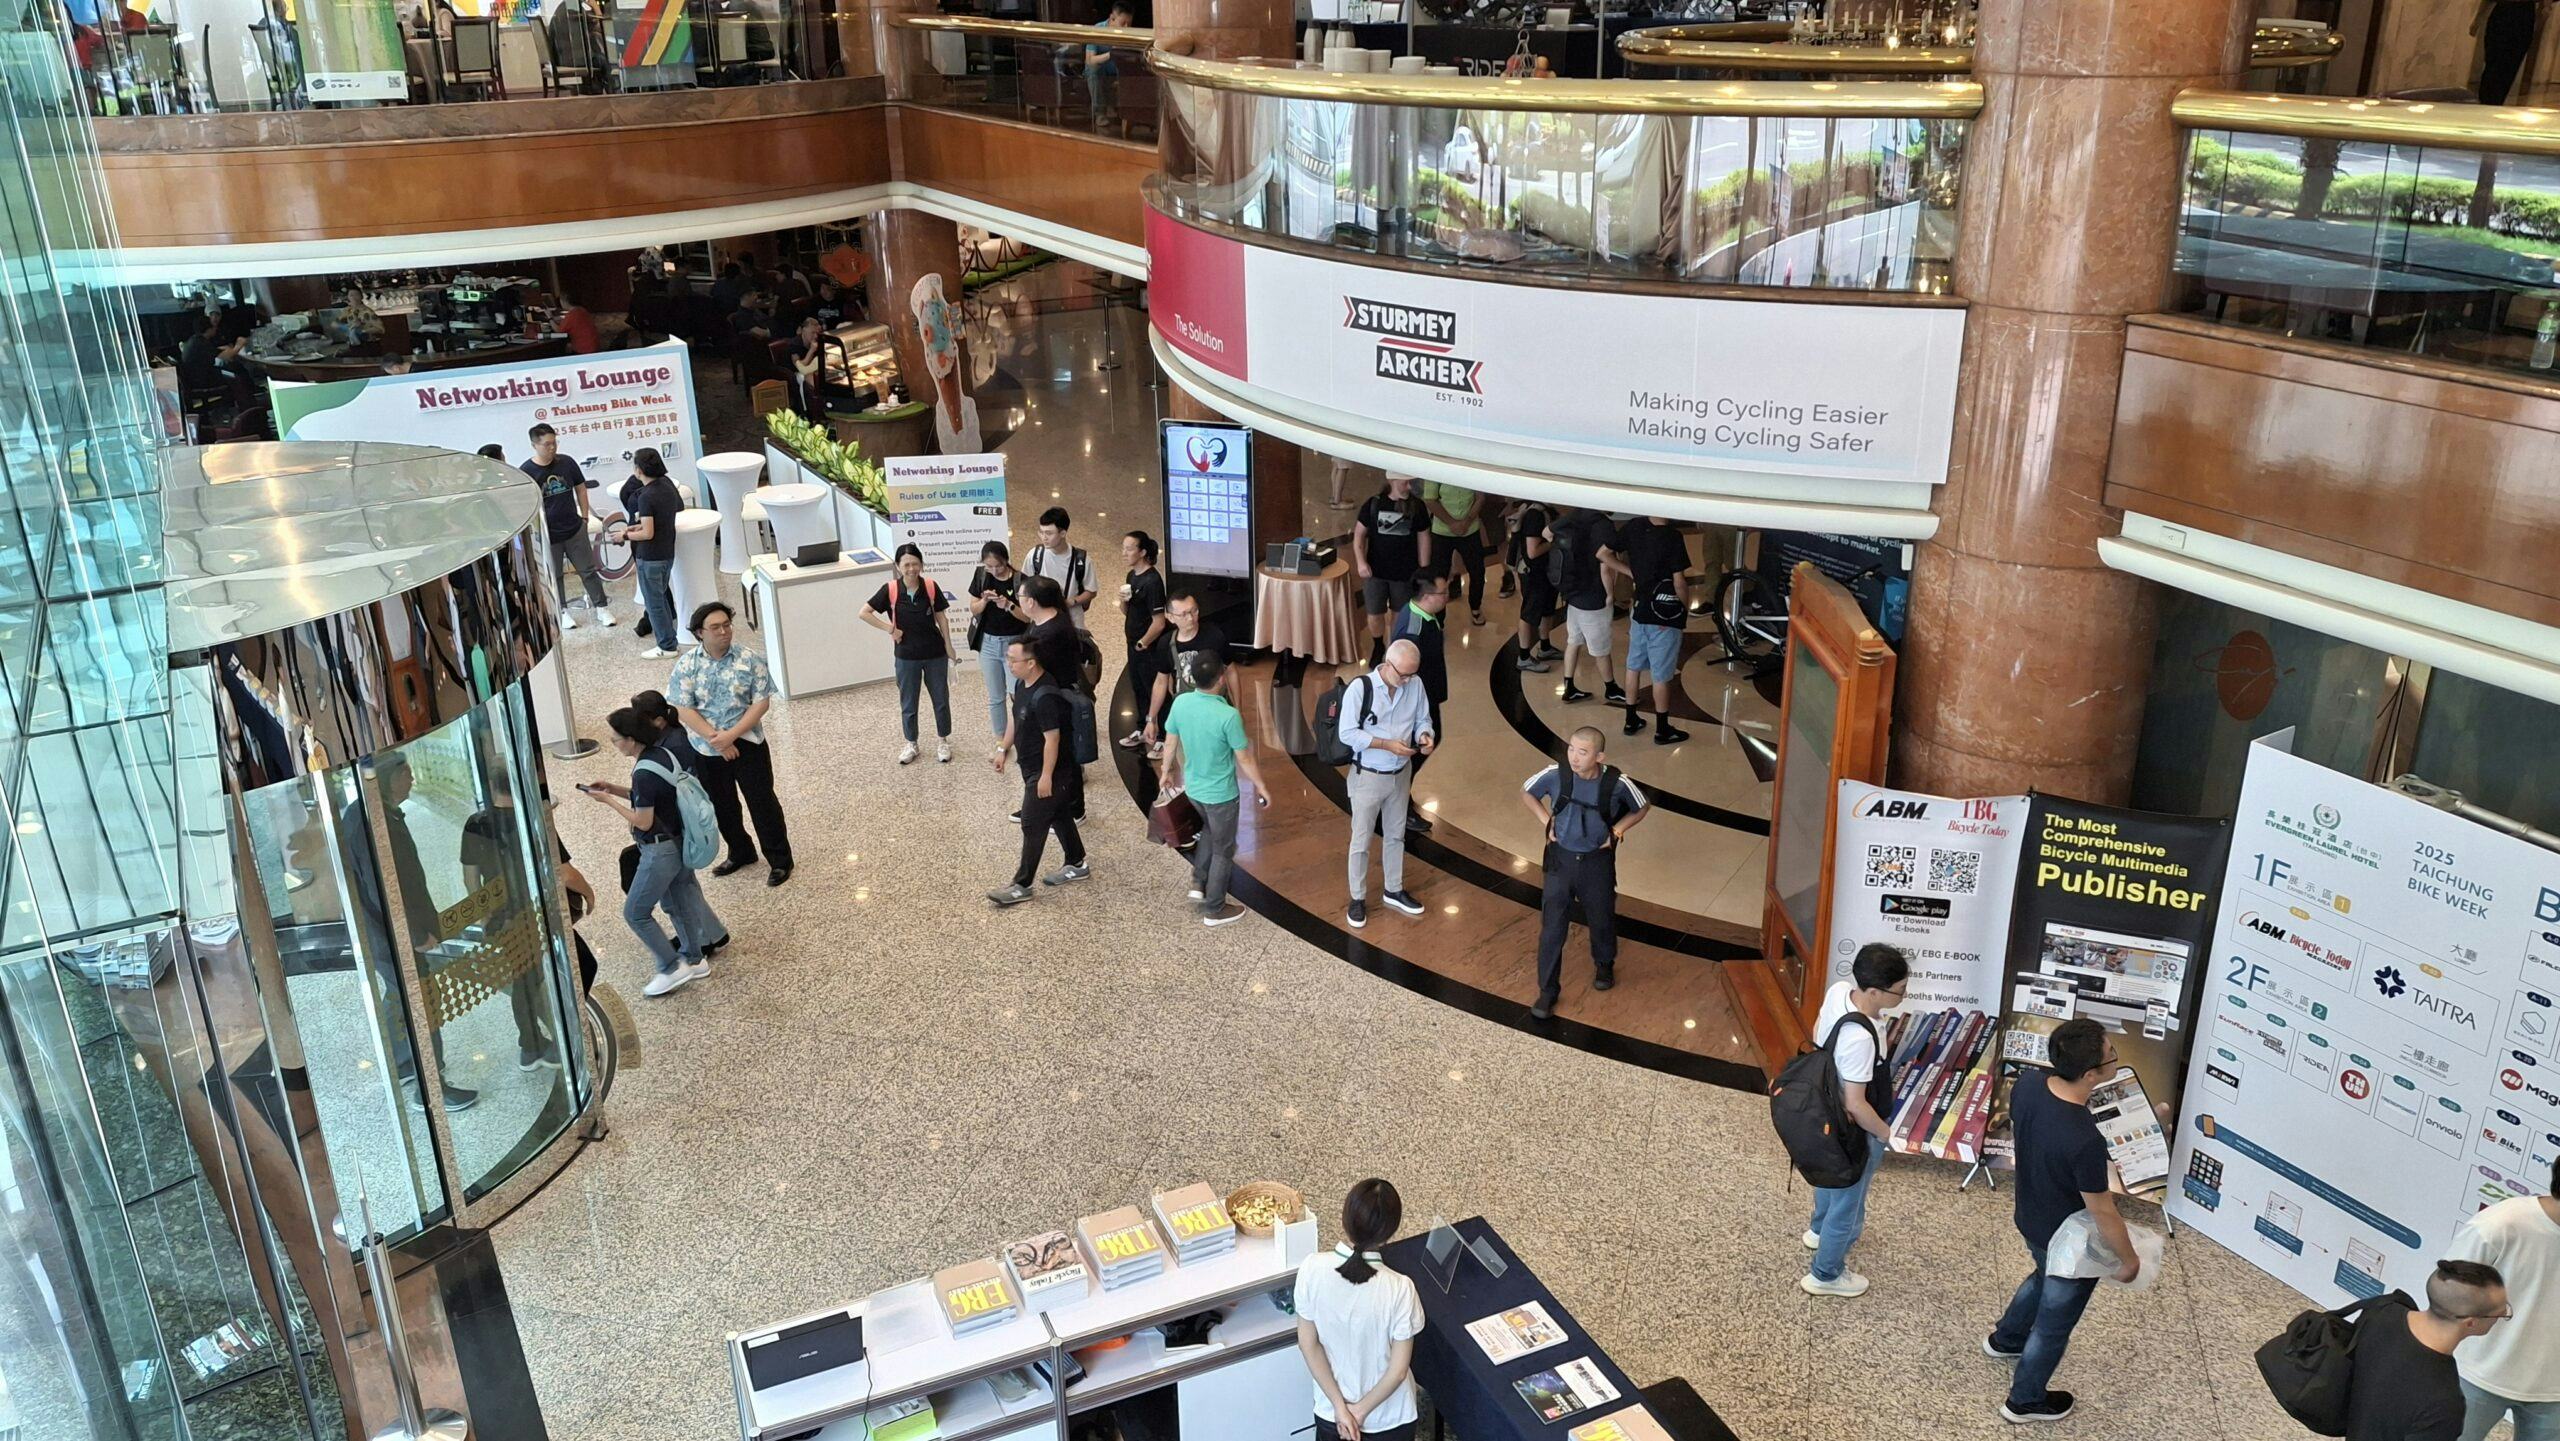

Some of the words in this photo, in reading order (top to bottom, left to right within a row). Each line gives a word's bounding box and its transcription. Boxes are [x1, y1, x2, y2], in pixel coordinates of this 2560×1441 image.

[1358, 302, 1452, 339] STURMEY
[1174, 313, 1188, 336] The
[1188, 323, 1224, 353] Solution
[1379, 350, 1466, 386] ARCHER
[416, 376, 568, 409] Networking
[577, 366, 671, 390] Lounge
[551, 402, 608, 416] Taichung
[612, 398, 638, 410] Bike
[641, 394, 672, 406] Week
[1436, 392, 1455, 402] EST.
[1461, 396, 1484, 408] 1902
[1630, 390, 1708, 418] Making
[1716, 398, 1803, 426] Cycling
[1812, 404, 1889, 426] Easier
[628, 426, 679, 440] 9.16-9.18
[1628, 416, 1707, 444] Making
[1714, 424, 1801, 452] Cycling
[1810, 431, 1874, 452] Safer
[892, 466, 954, 476] Networking
[958, 464, 999, 474] Lounge
[900, 492, 924, 500] Rules
[914, 512, 939, 520] Buyers
[978, 507, 998, 515] FREE
[1840, 536, 1850, 545] to
[1850, 540, 1882, 555] market.
[1866, 800, 1929, 820] ABM
[1960, 800, 2000, 822] TBG
[1947, 820, 1979, 834] Bicycle
[1982, 824, 2010, 838] Today
[2045, 813, 2074, 828] The
[2078, 818, 2118, 835] Most
[2042, 828, 2166, 858] Comprehensive
[2265, 819, 2314, 843] EVERGREEN
[2316, 840, 2348, 857] LAUREL
[2350, 853, 2380, 870] HOTEL
[2414, 842, 2455, 866] 2025
[2040, 844, 2098, 863] Bicycle
[2101, 852, 2188, 878] Multimedia
[2254, 853, 2292, 887] 1F
[2036, 862, 2206, 912] Publisher
[2412, 859, 2494, 902] TAICHUNG
[2407, 877, 2441, 900] BIKE
[2445, 891, 2489, 920] WEEK
[1882, 914, 1902, 923] Free
[1903, 916, 1946, 927] Download
[1900, 904, 1930, 915] Google
[1930, 906, 1948, 916] play
[1895, 924, 1930, 934] E-books
[2247, 918, 2286, 940] ABM
[1922, 950, 1942, 958] EBG
[1944, 952, 1981, 962] E-BOOK
[2290, 934, 2322, 956] Bicycle
[2326, 948, 2352, 970] Today
[1926, 971, 1962, 981] Partners
[2226, 956, 2270, 991] 2F
[1934, 992, 1980, 1004] Worldwide
[2412, 987, 2476, 1031] TAITRA
[2526, 1083, 2560, 1107] Mag
[2500, 1138, 2522, 1153] Bike
[1172, 1205, 1231, 1237] TBG
[1095, 1228, 1157, 1262] TBG
[1029, 1276, 1052, 1288] Today
[1054, 1268, 1081, 1280] Bicycle
[948, 1280, 1011, 1317] EBG
[798, 1350, 818, 1360] ASUS
